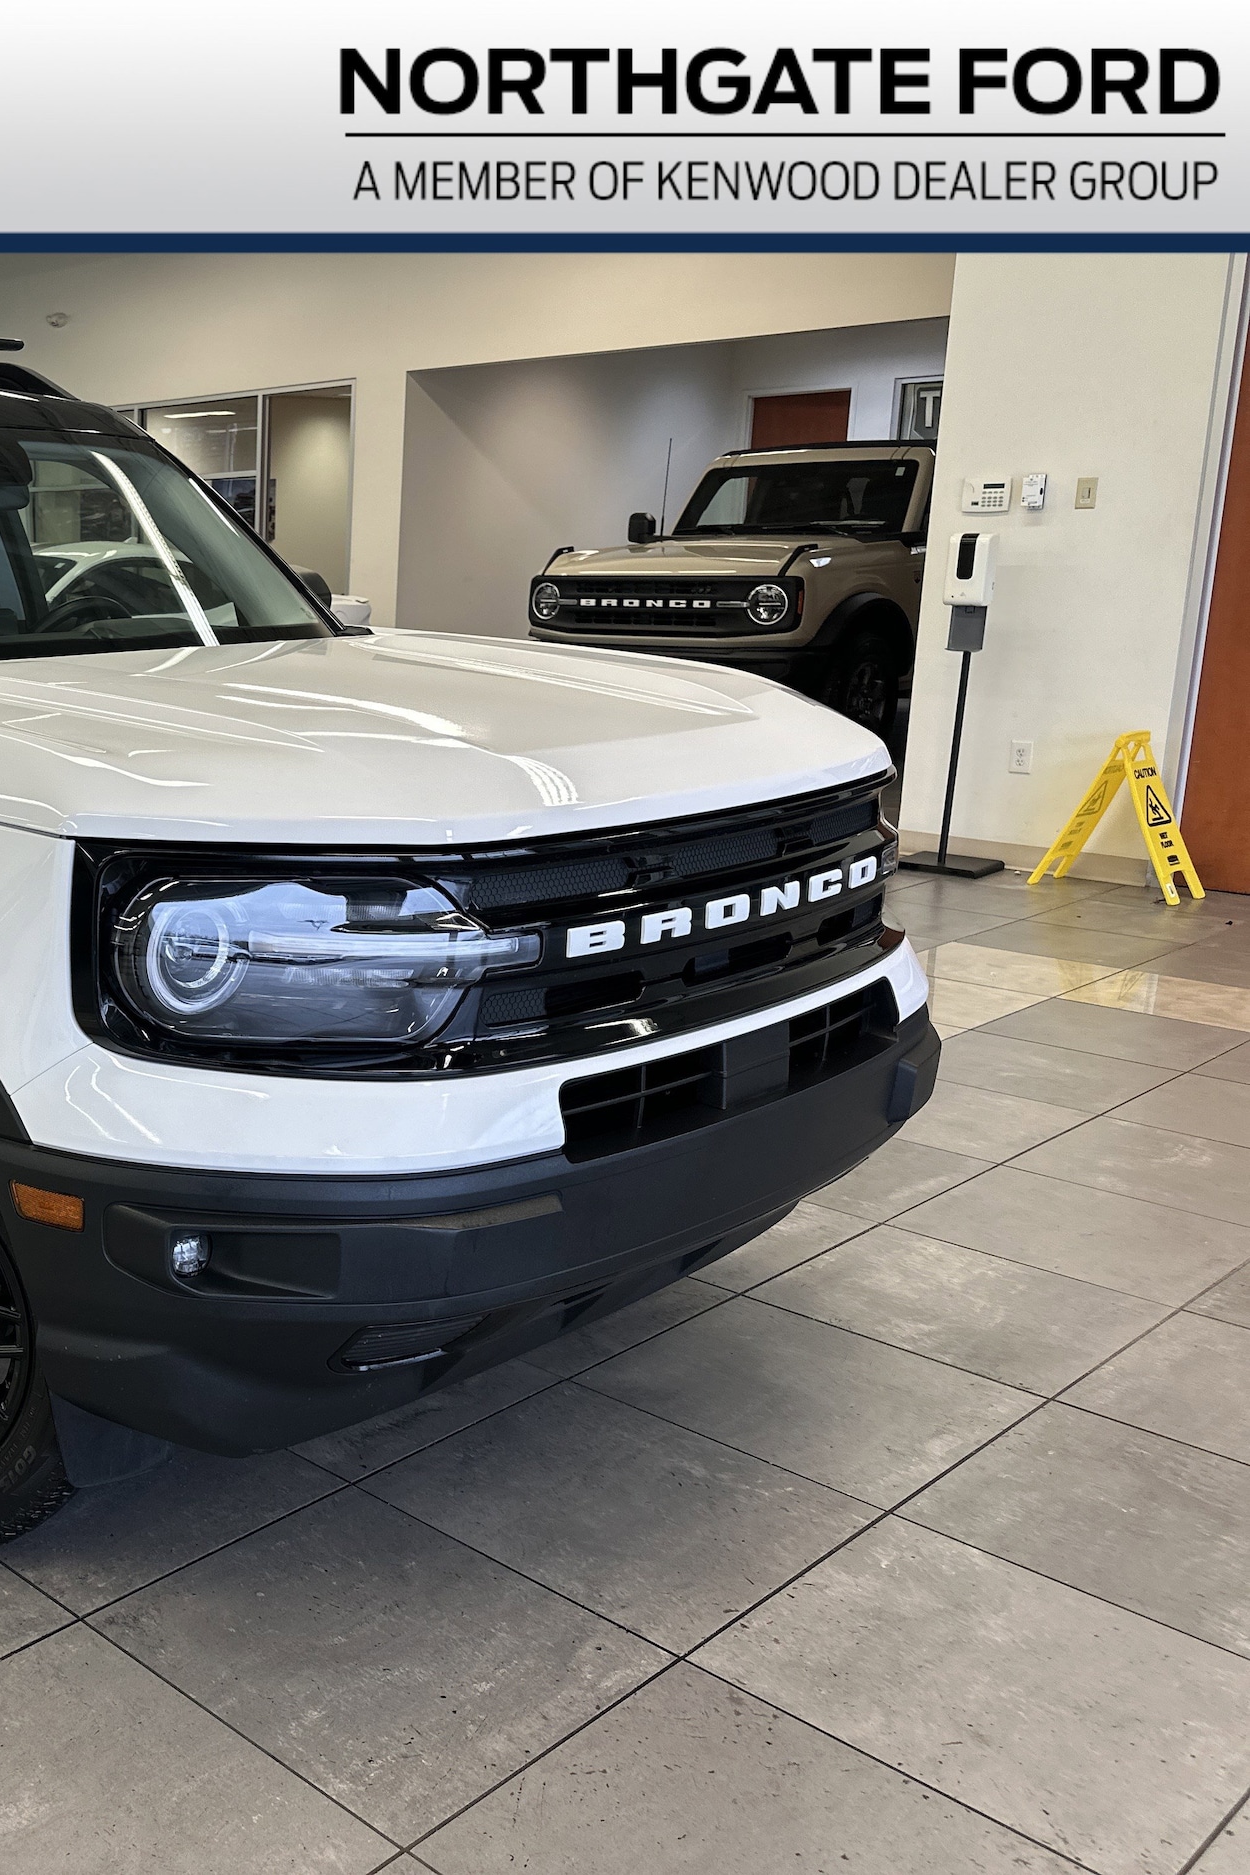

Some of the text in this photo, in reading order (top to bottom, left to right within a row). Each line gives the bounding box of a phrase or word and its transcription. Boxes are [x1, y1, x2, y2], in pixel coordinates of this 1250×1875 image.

[579, 598, 711, 608] BRONCO
[1134, 766, 1157, 779] CAUTION
[565, 855, 877, 958] BRONCO
